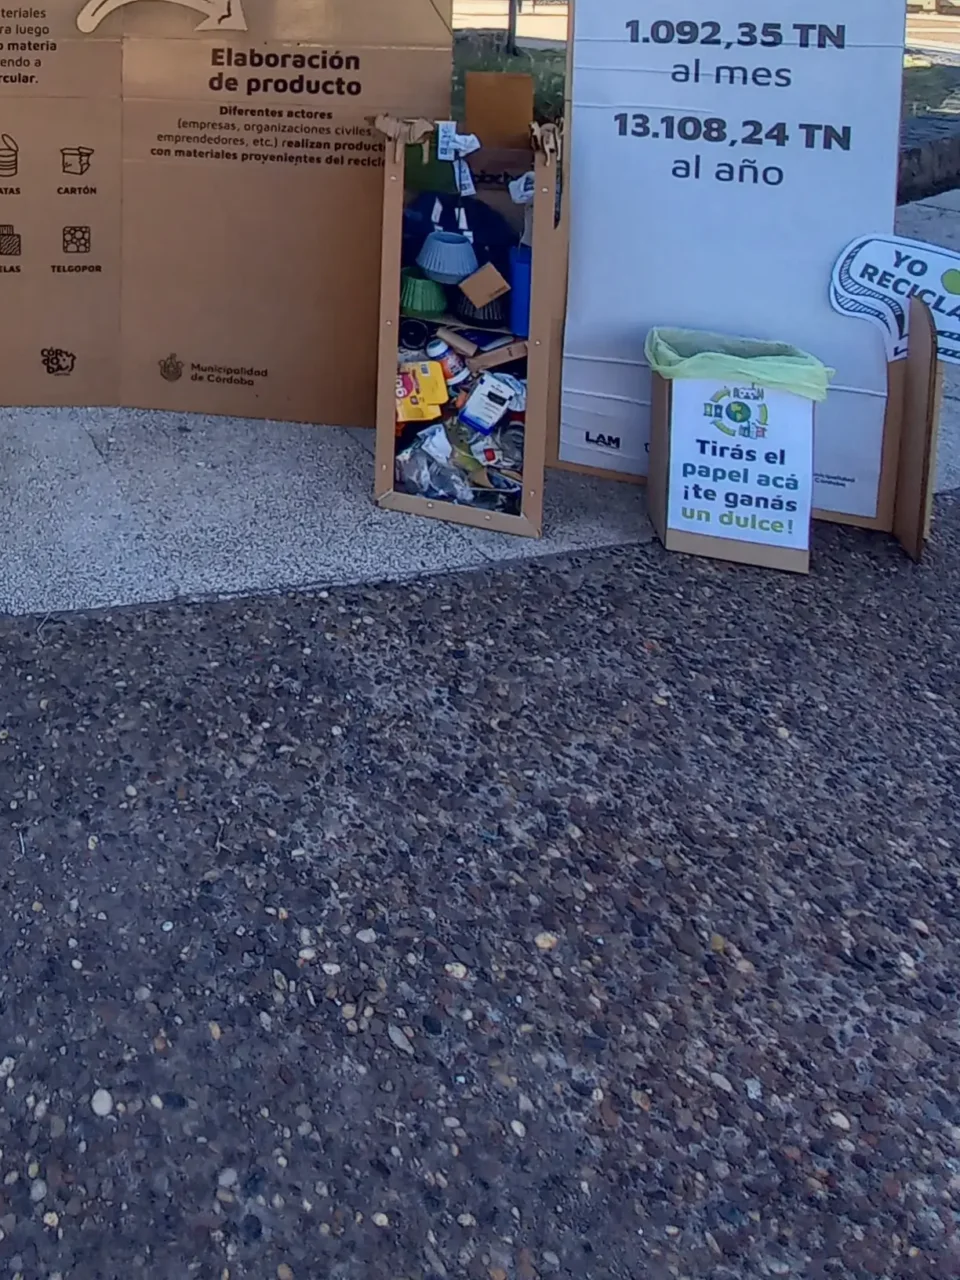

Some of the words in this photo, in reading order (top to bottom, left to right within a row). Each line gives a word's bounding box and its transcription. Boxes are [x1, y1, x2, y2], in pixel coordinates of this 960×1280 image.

[15, 23, 50, 37] luego
[625, 19, 783, 49] 1.092,35
[792, 23, 846, 49] TN
[7, 40, 57, 52] materia
[34, 59, 42, 68] a
[211, 48, 360, 70] Elaboración
[671, 58, 700, 83] al
[715, 65, 792, 87] mes
[209, 72, 238, 92] de
[246, 74, 362, 96] producto
[219, 106, 283, 118] Diferentes
[287, 109, 333, 120] actores
[177, 118, 240, 132] (empresas,
[244, 123, 331, 136] organizaciones
[613, 113, 790, 148] 13.108,24
[798, 123, 852, 151] TN
[157, 132, 248, 148] emprendedores,
[252, 137, 278, 149] etc.)
[282, 138, 331, 150] realizan
[334, 141, 386, 152] product
[150, 148, 171, 157] con
[174, 148, 238, 160] materiales
[241, 152, 321, 165] provenientes
[325, 154, 344, 165] del
[671, 155, 700, 179] al
[715, 158, 784, 186] año
[56, 185, 97, 196] CARTÓN
[50, 264, 102, 274] TELGOPOR
[893, 249, 928, 277] YO
[190, 372, 204, 381] de
[191, 363, 268, 377] Municipalidad
[585, 431, 620, 449] LAM
[696, 439, 757, 462] Tirás
[764, 449, 785, 465] el
[682, 462, 749, 484] papel
[757, 474, 799, 490] acá
[683, 484, 717, 501] ¡te
[724, 491, 797, 512] ganás
[681, 506, 711, 522] un
[719, 510, 793, 535] dulce!
